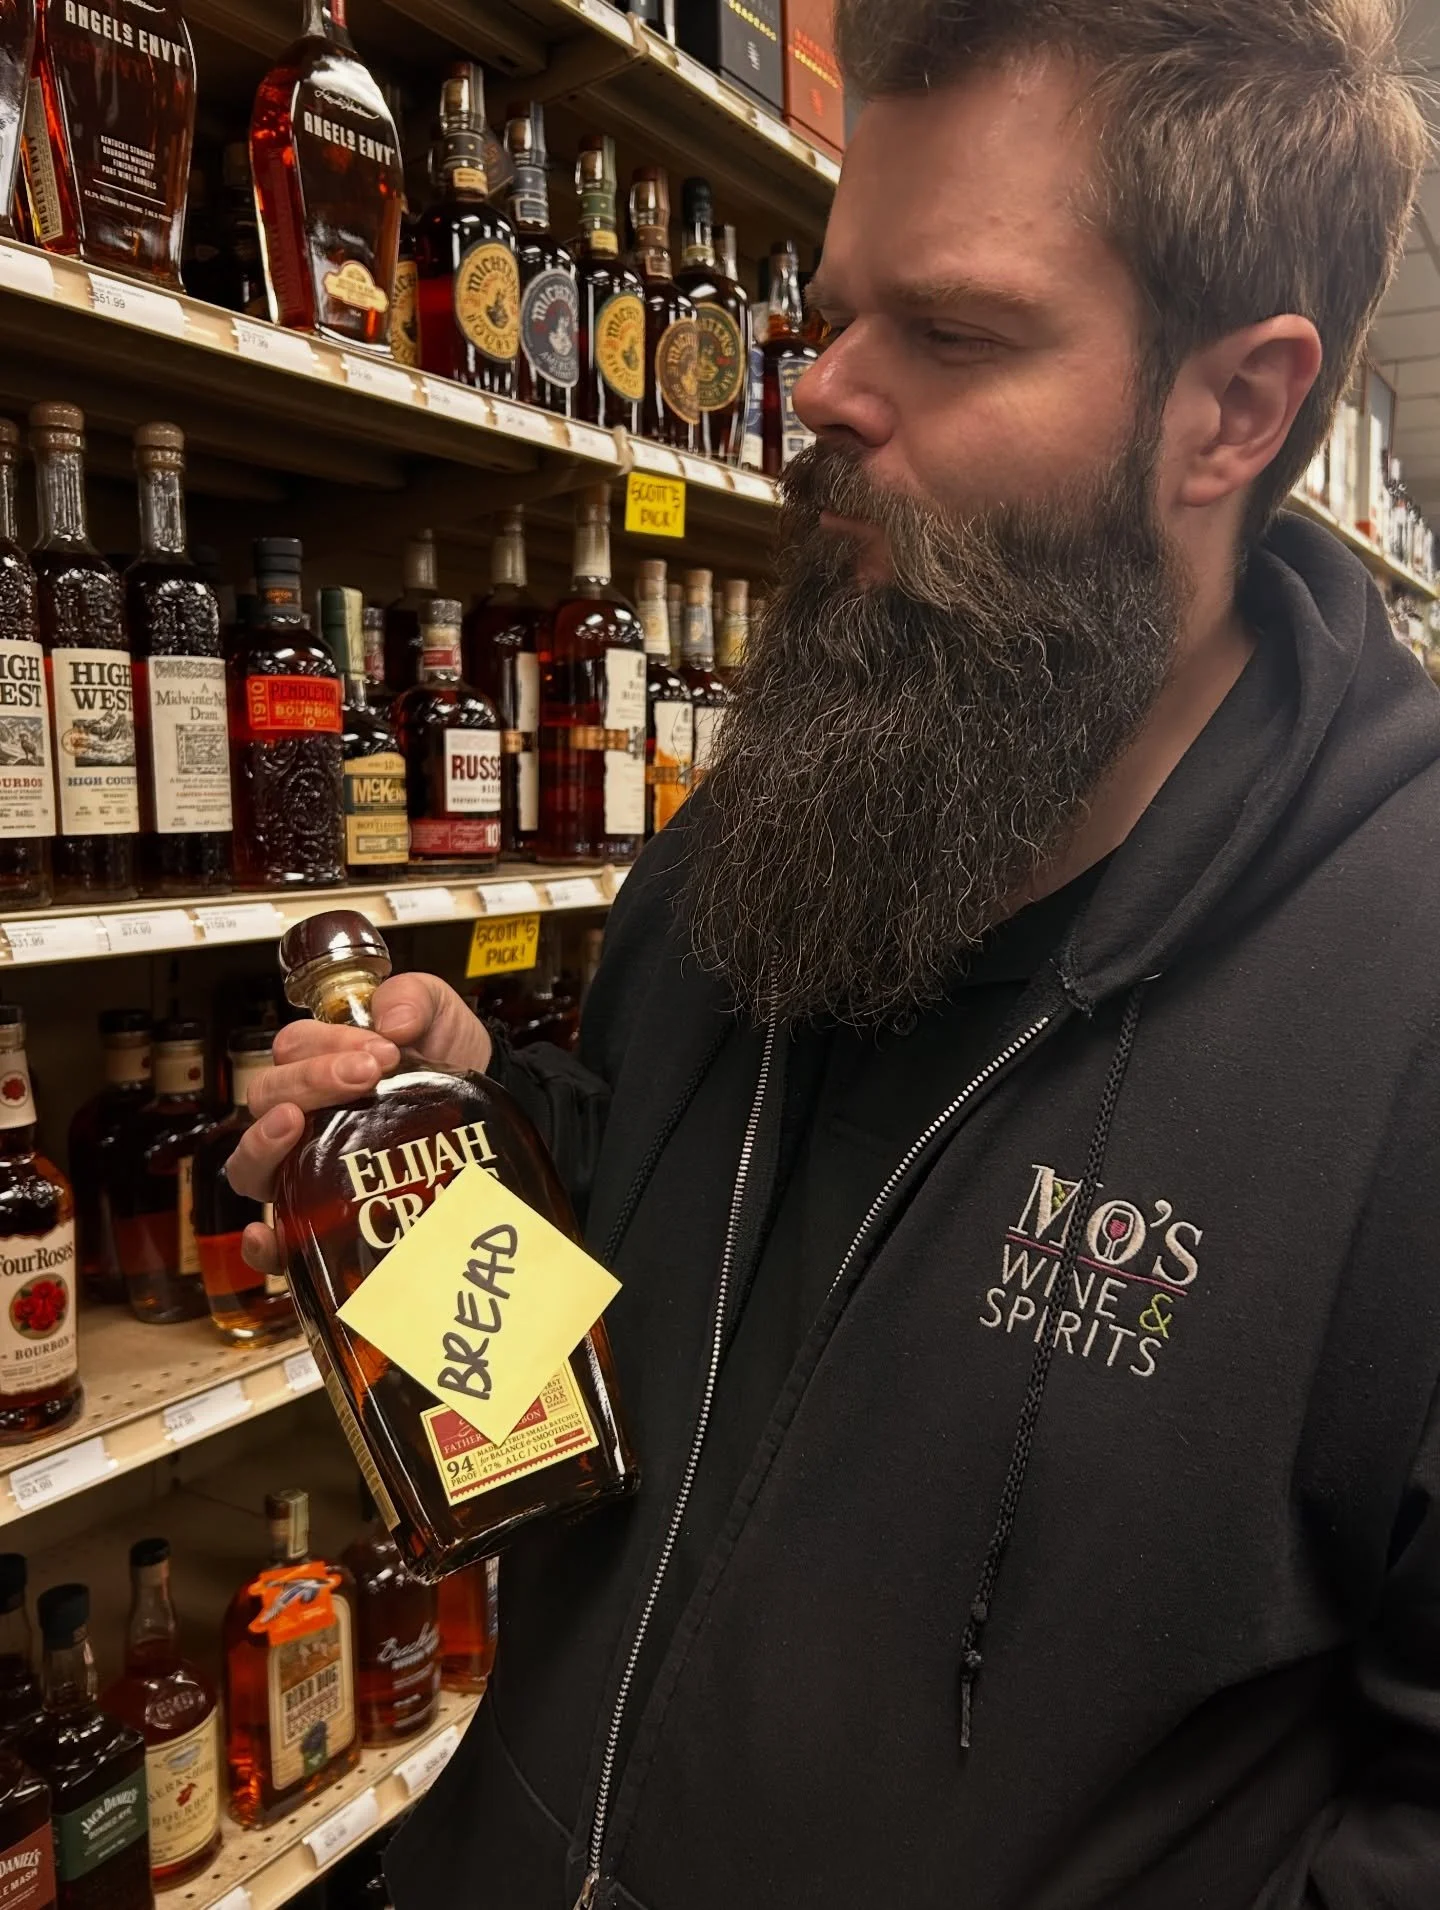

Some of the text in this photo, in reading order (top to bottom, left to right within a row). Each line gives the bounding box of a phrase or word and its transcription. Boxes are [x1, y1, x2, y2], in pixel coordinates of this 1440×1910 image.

[65, 0, 181, 67] ANGELS ENVY
[304, 111, 391, 166] ANGELS ENVY
[69, 661, 132, 687] HIGH
[71, 688, 133, 711] WEST
[154, 690, 213, 706] Midwinter
[201, 682, 209, 694] A
[251, 681, 267, 723] 1910
[275, 704, 336, 719] BOURBON
[477, 917, 537, 949] SCOTT'S
[485, 944, 525, 968] PICK!
[339, 1120, 498, 1202] ELIJAH
[1008, 1164, 1204, 1286] MO'S
[1001, 1244, 1174, 1339] WINE &
[437, 1223, 518, 1400] BREAD
[979, 1287, 1163, 1377] SPIRITS
[15, 1337, 69, 1361] BOURBON
[544, 1392, 567, 1404] OAK
[508, 1434, 526, 1446] TRUE
[526, 1425, 548, 1438] SMALL
[549, 1412, 579, 1427] BATCHES
[444, 1433, 483, 1454] FATHER
[480, 1457, 490, 1466] for
[490, 1442, 528, 1460] BALANCE
[532, 1419, 583, 1442] SMOOTHNESS
[447, 1455, 475, 1479] 94
[451, 1471, 478, 1487] PROOF
[483, 1461, 502, 1475] 47%
[81, 1806, 105, 1834] JACK
[10, 1867, 38, 1891] MASH
